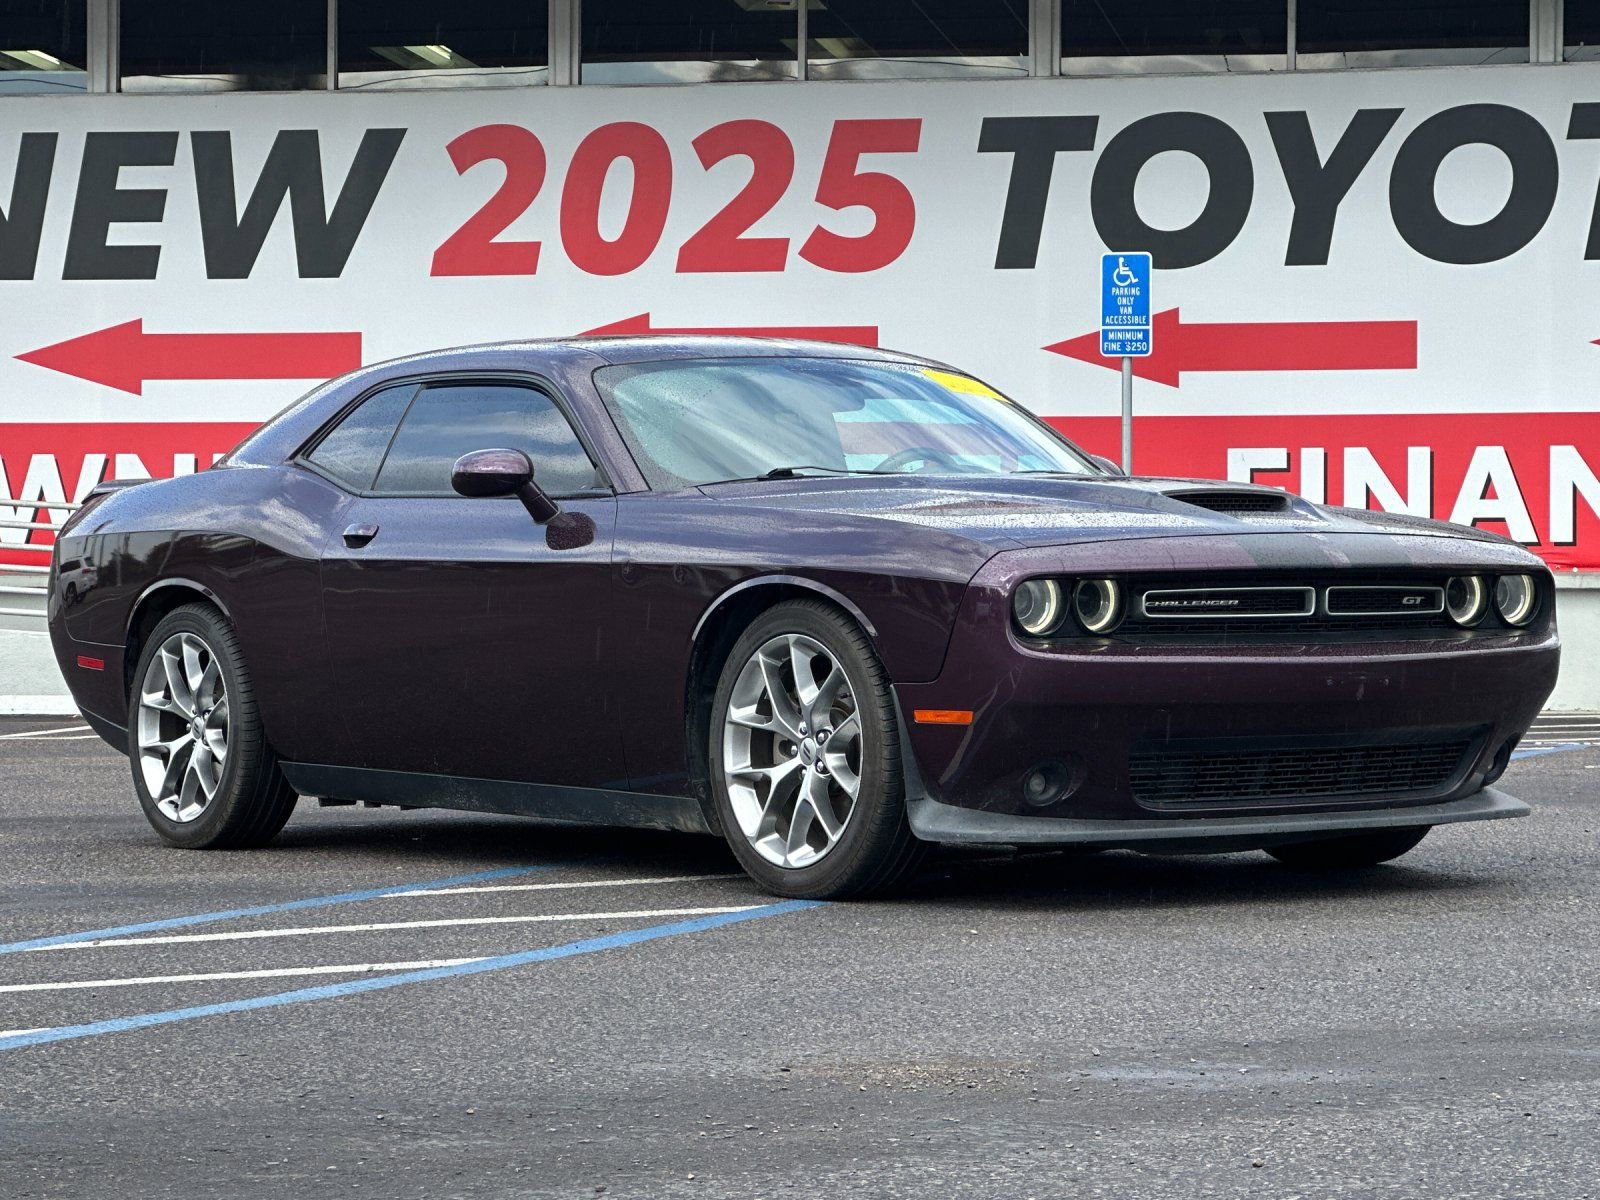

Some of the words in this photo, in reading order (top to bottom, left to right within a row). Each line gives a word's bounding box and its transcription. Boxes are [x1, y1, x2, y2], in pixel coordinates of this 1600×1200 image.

[430, 118, 922, 276] 2025
[977, 102, 1600, 269] TOYO
[1111, 287, 1140, 296] PARKING
[1117, 296, 1134, 305] ONLY
[1119, 306, 1132, 315] VAN
[1105, 315, 1147, 324] ACCESSIBLE
[1108, 331, 1143, 340] MINIMUM
[1104, 342, 1121, 351] FINE
[1124, 341, 1147, 352] $250
[1402, 596, 1425, 604] GT
